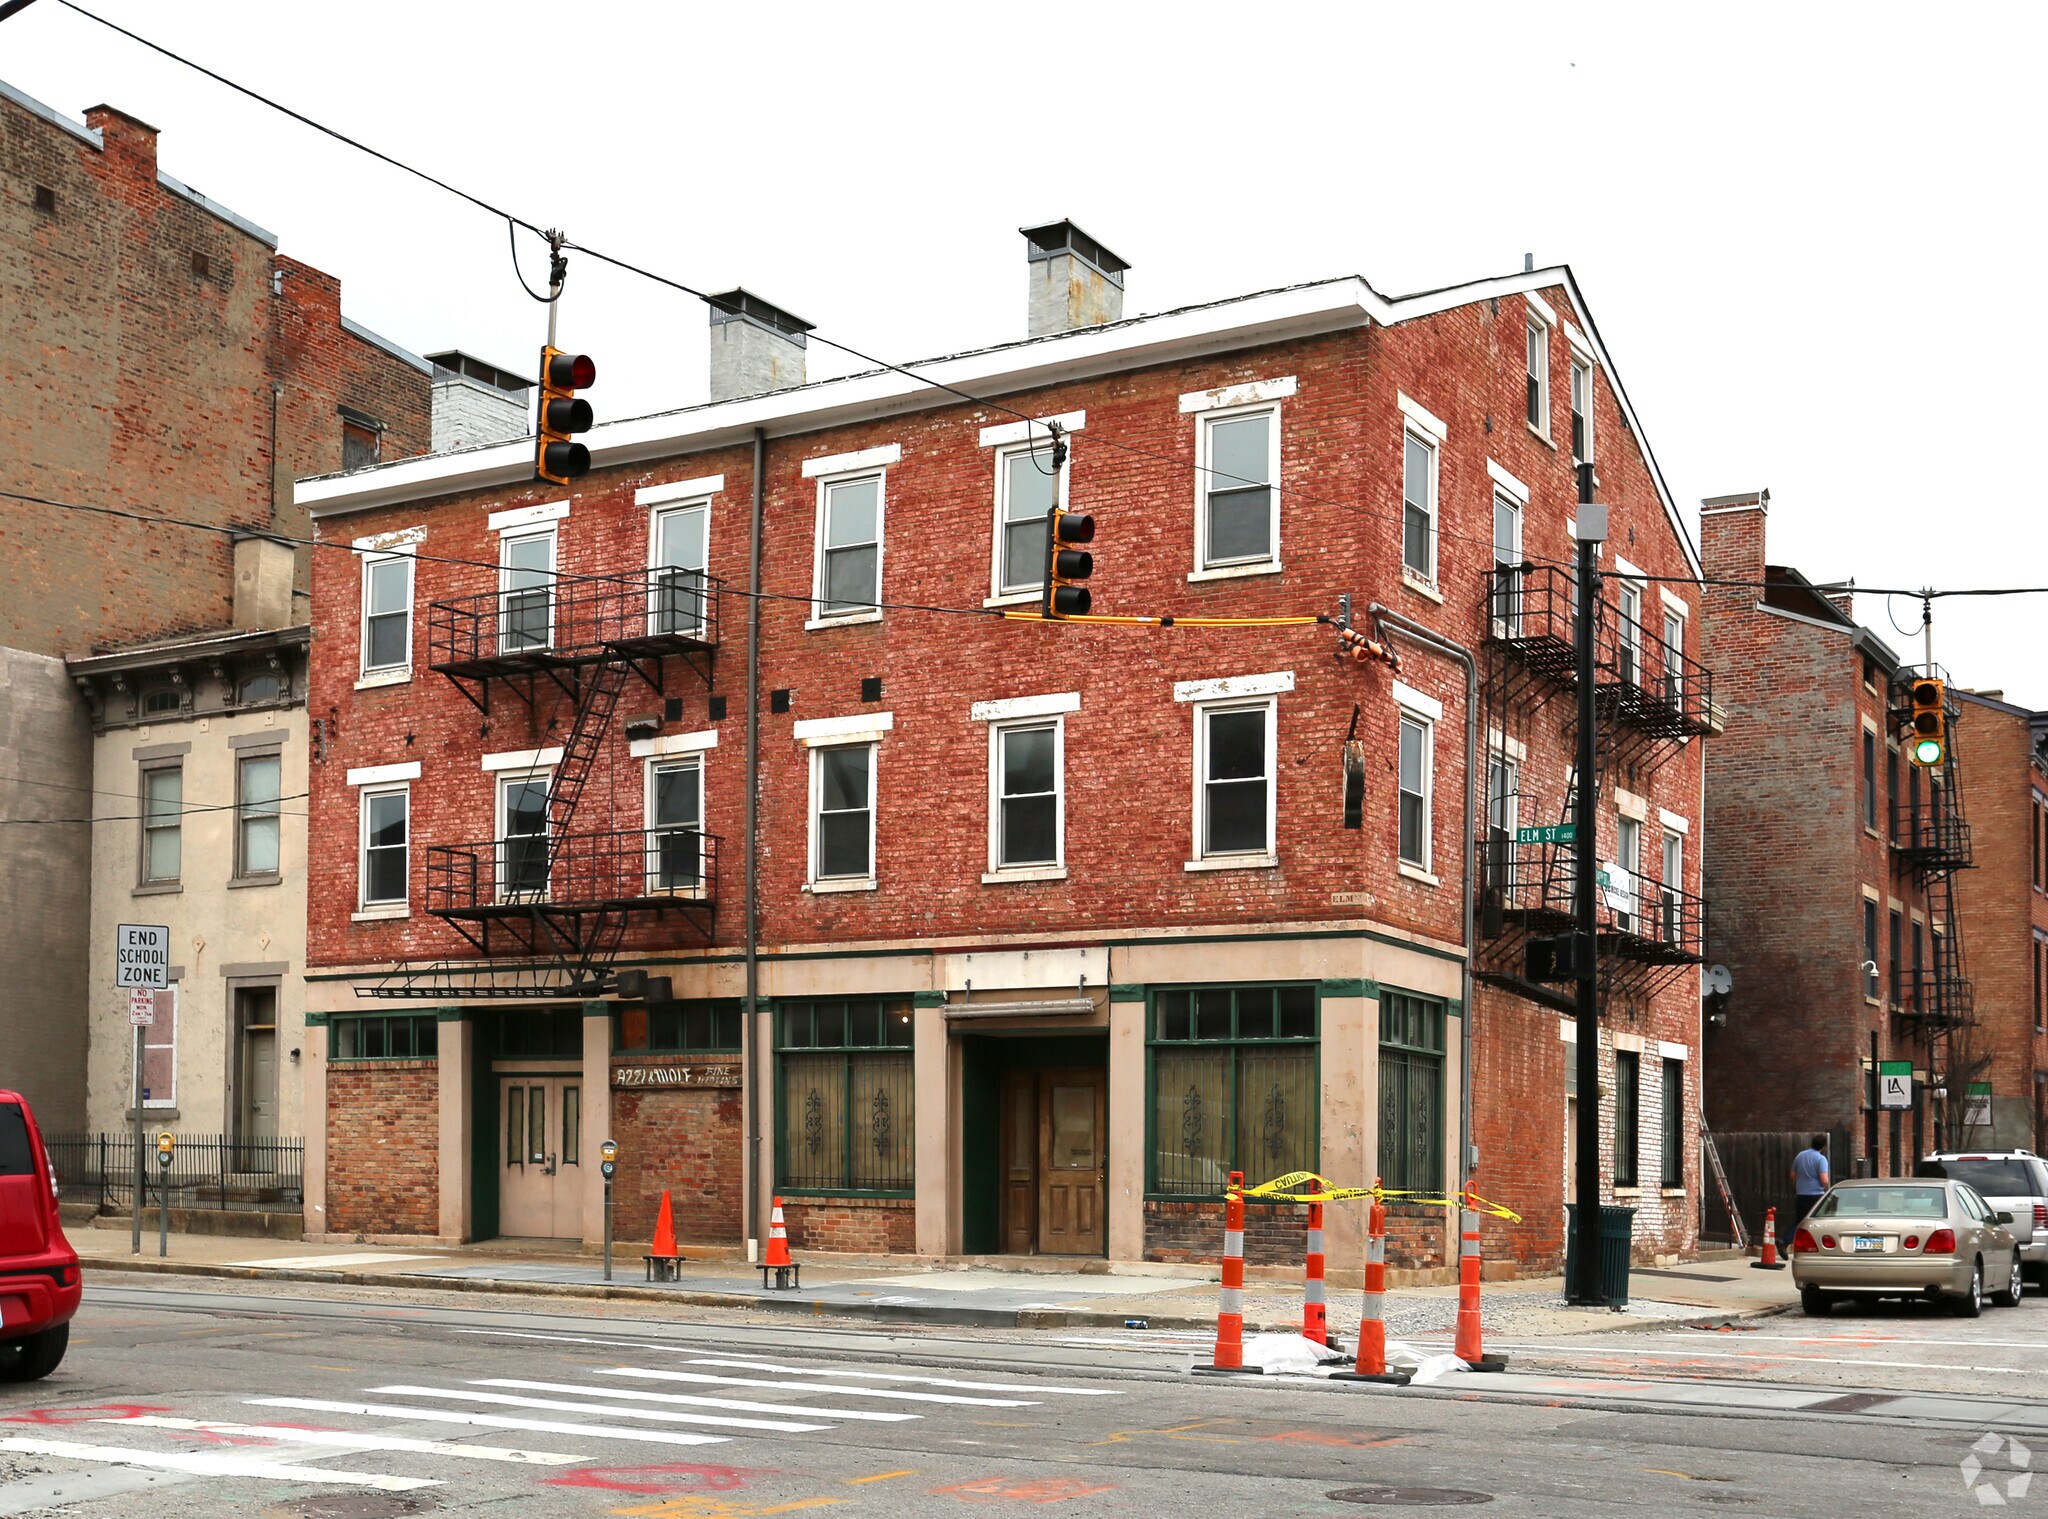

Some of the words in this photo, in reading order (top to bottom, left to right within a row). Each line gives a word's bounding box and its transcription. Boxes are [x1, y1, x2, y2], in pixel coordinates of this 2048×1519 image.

[1520, 829, 1539, 842] ELM
[1545, 828, 1557, 840] ST
[1333, 895, 1353, 903] ELM
[129, 931, 157, 946] END
[120, 949, 165, 965] SCHOOL
[124, 967, 161, 982] ZONE
[137, 989, 147, 997] NO
[131, 997, 153, 1005] PARKING
[704, 1067, 731, 1076] FINE
